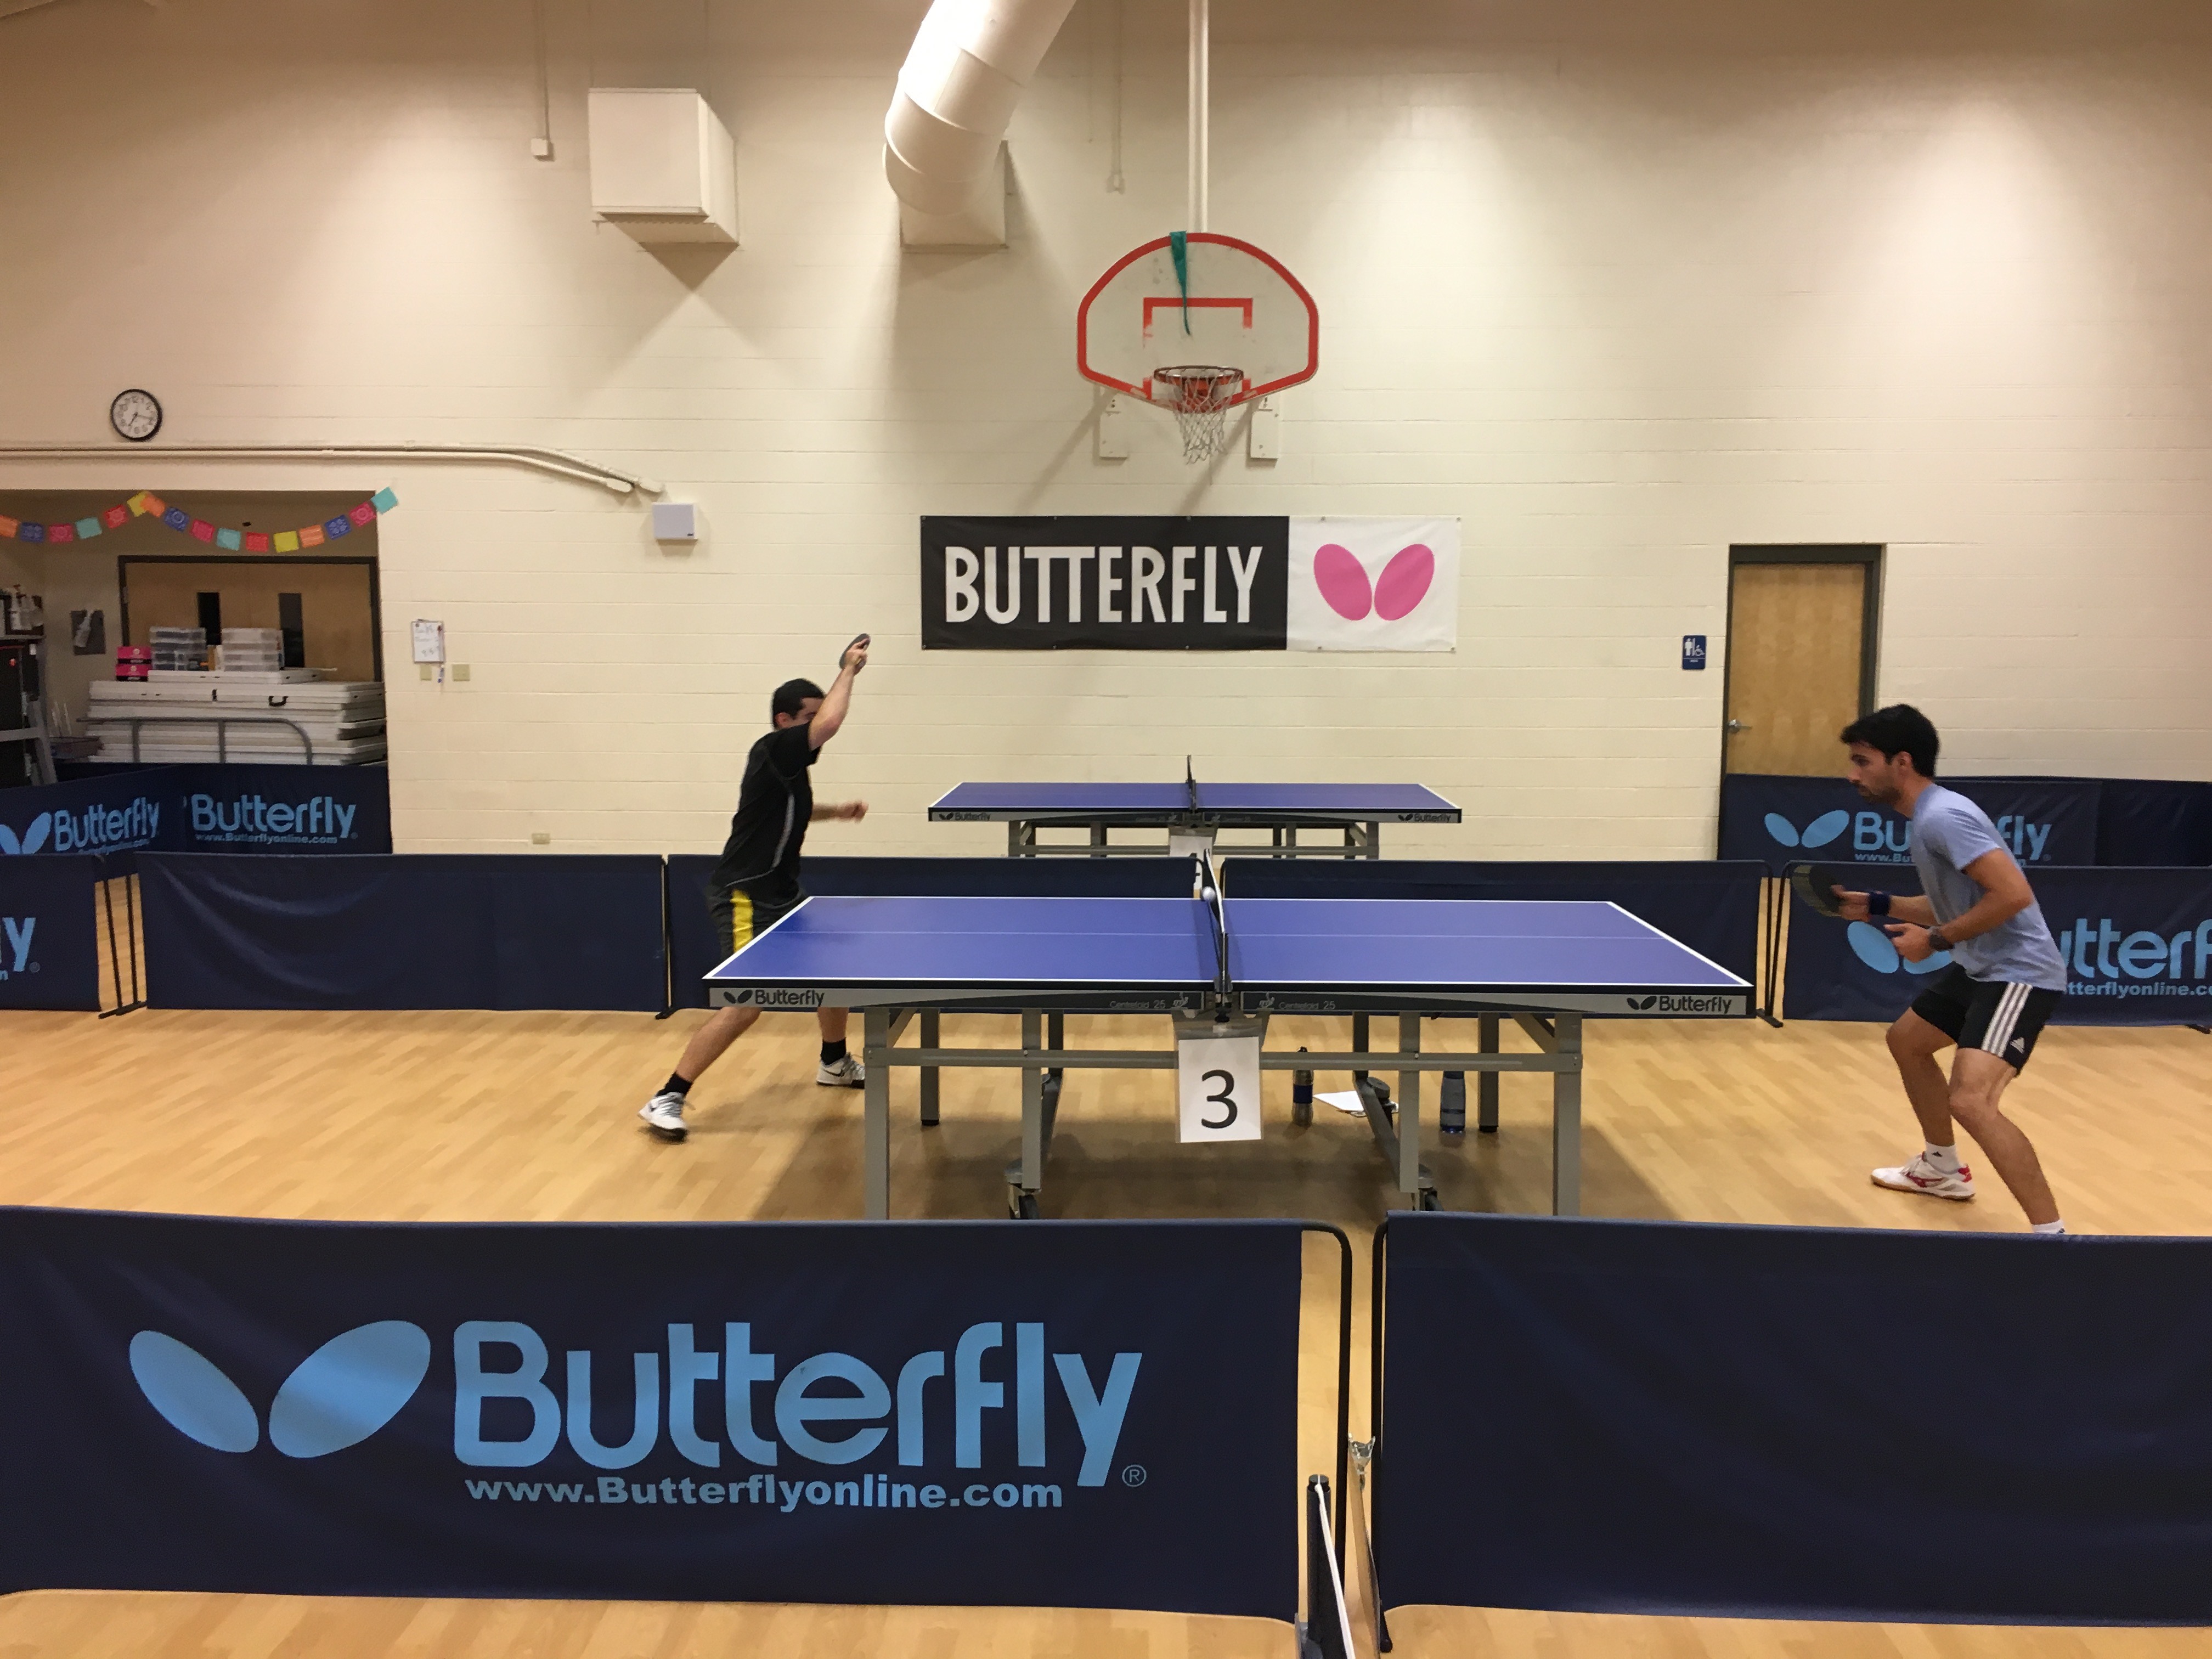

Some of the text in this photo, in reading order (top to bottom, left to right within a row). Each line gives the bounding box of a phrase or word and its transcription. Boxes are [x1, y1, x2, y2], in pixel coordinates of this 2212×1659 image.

[945, 546, 1263, 624] BUTTERFLY
[54, 797, 159, 851] Butterfly
[192, 794, 356, 839] Butterfly
[1854, 811, 2052, 861] Bufly
[755, 989, 825, 1007] Butterfly
[1153, 1000, 1166, 1009] 25
[1323, 1001, 1336, 1010] 25
[1659, 996, 1733, 1014] Butterfly
[1201, 1069, 1238, 1130] 3
[453, 1321, 1143, 1487] Butterfly
[465, 1474, 1062, 1513] www.Butterflyonline.com
